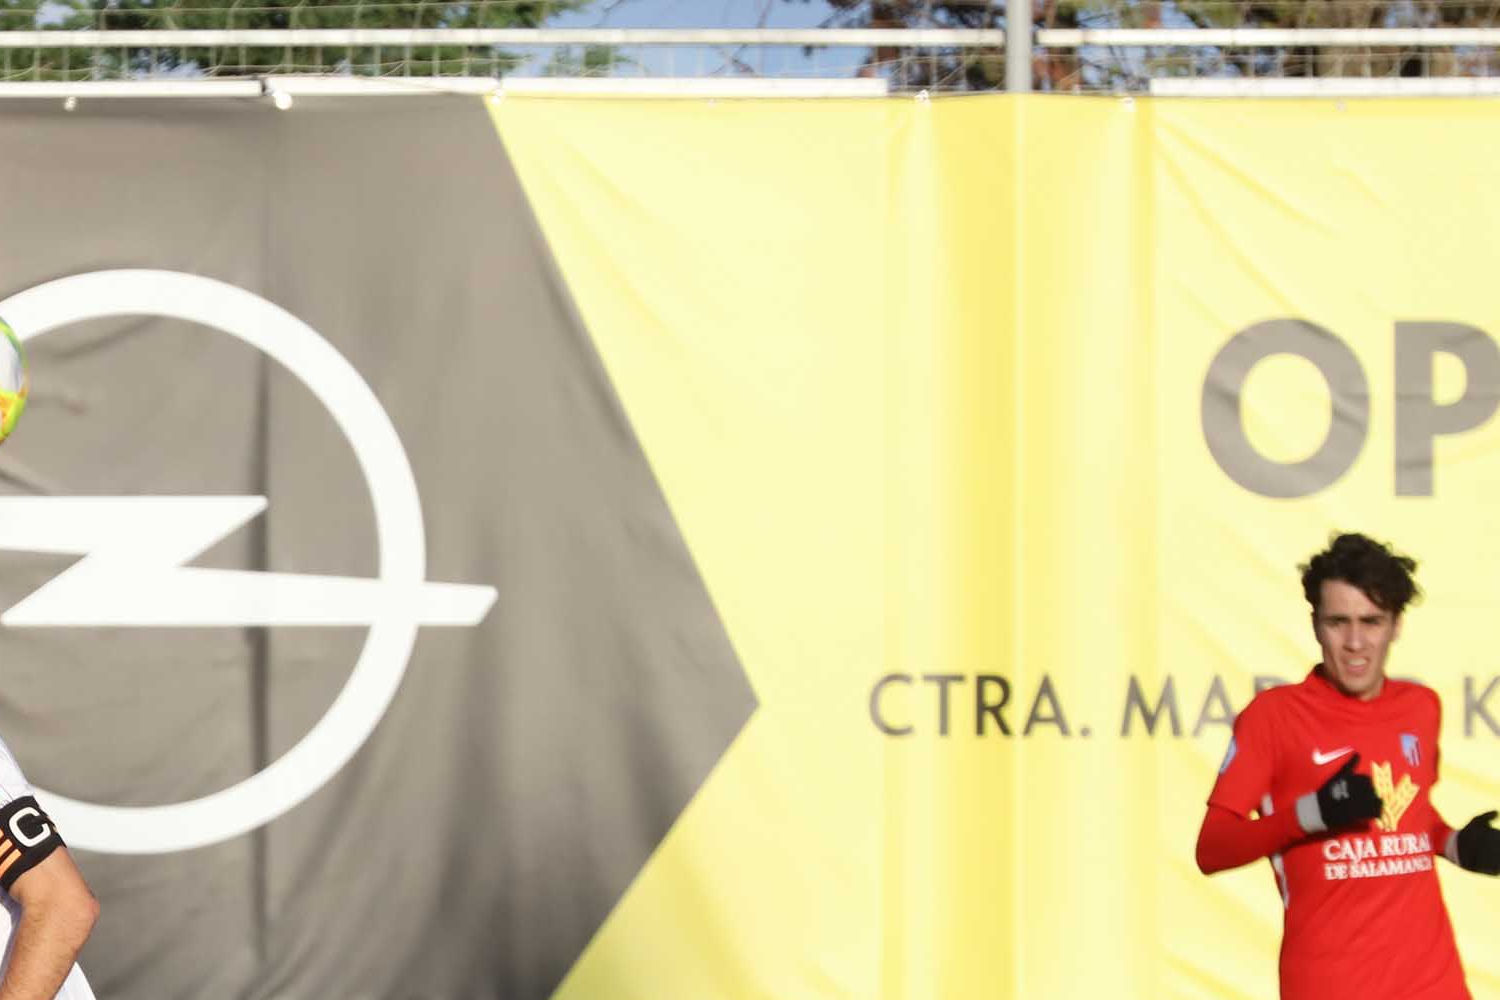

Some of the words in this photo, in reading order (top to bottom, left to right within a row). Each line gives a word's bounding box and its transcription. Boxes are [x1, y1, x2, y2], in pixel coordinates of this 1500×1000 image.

[1201, 317, 1500, 500] OP
[869, 673, 1091, 738] CTRA.
[8, 806, 52, 848] C
[1323, 837, 1378, 864] CAJA
[1380, 833, 1432, 857] RURA
[1324, 862, 1349, 881] DE
